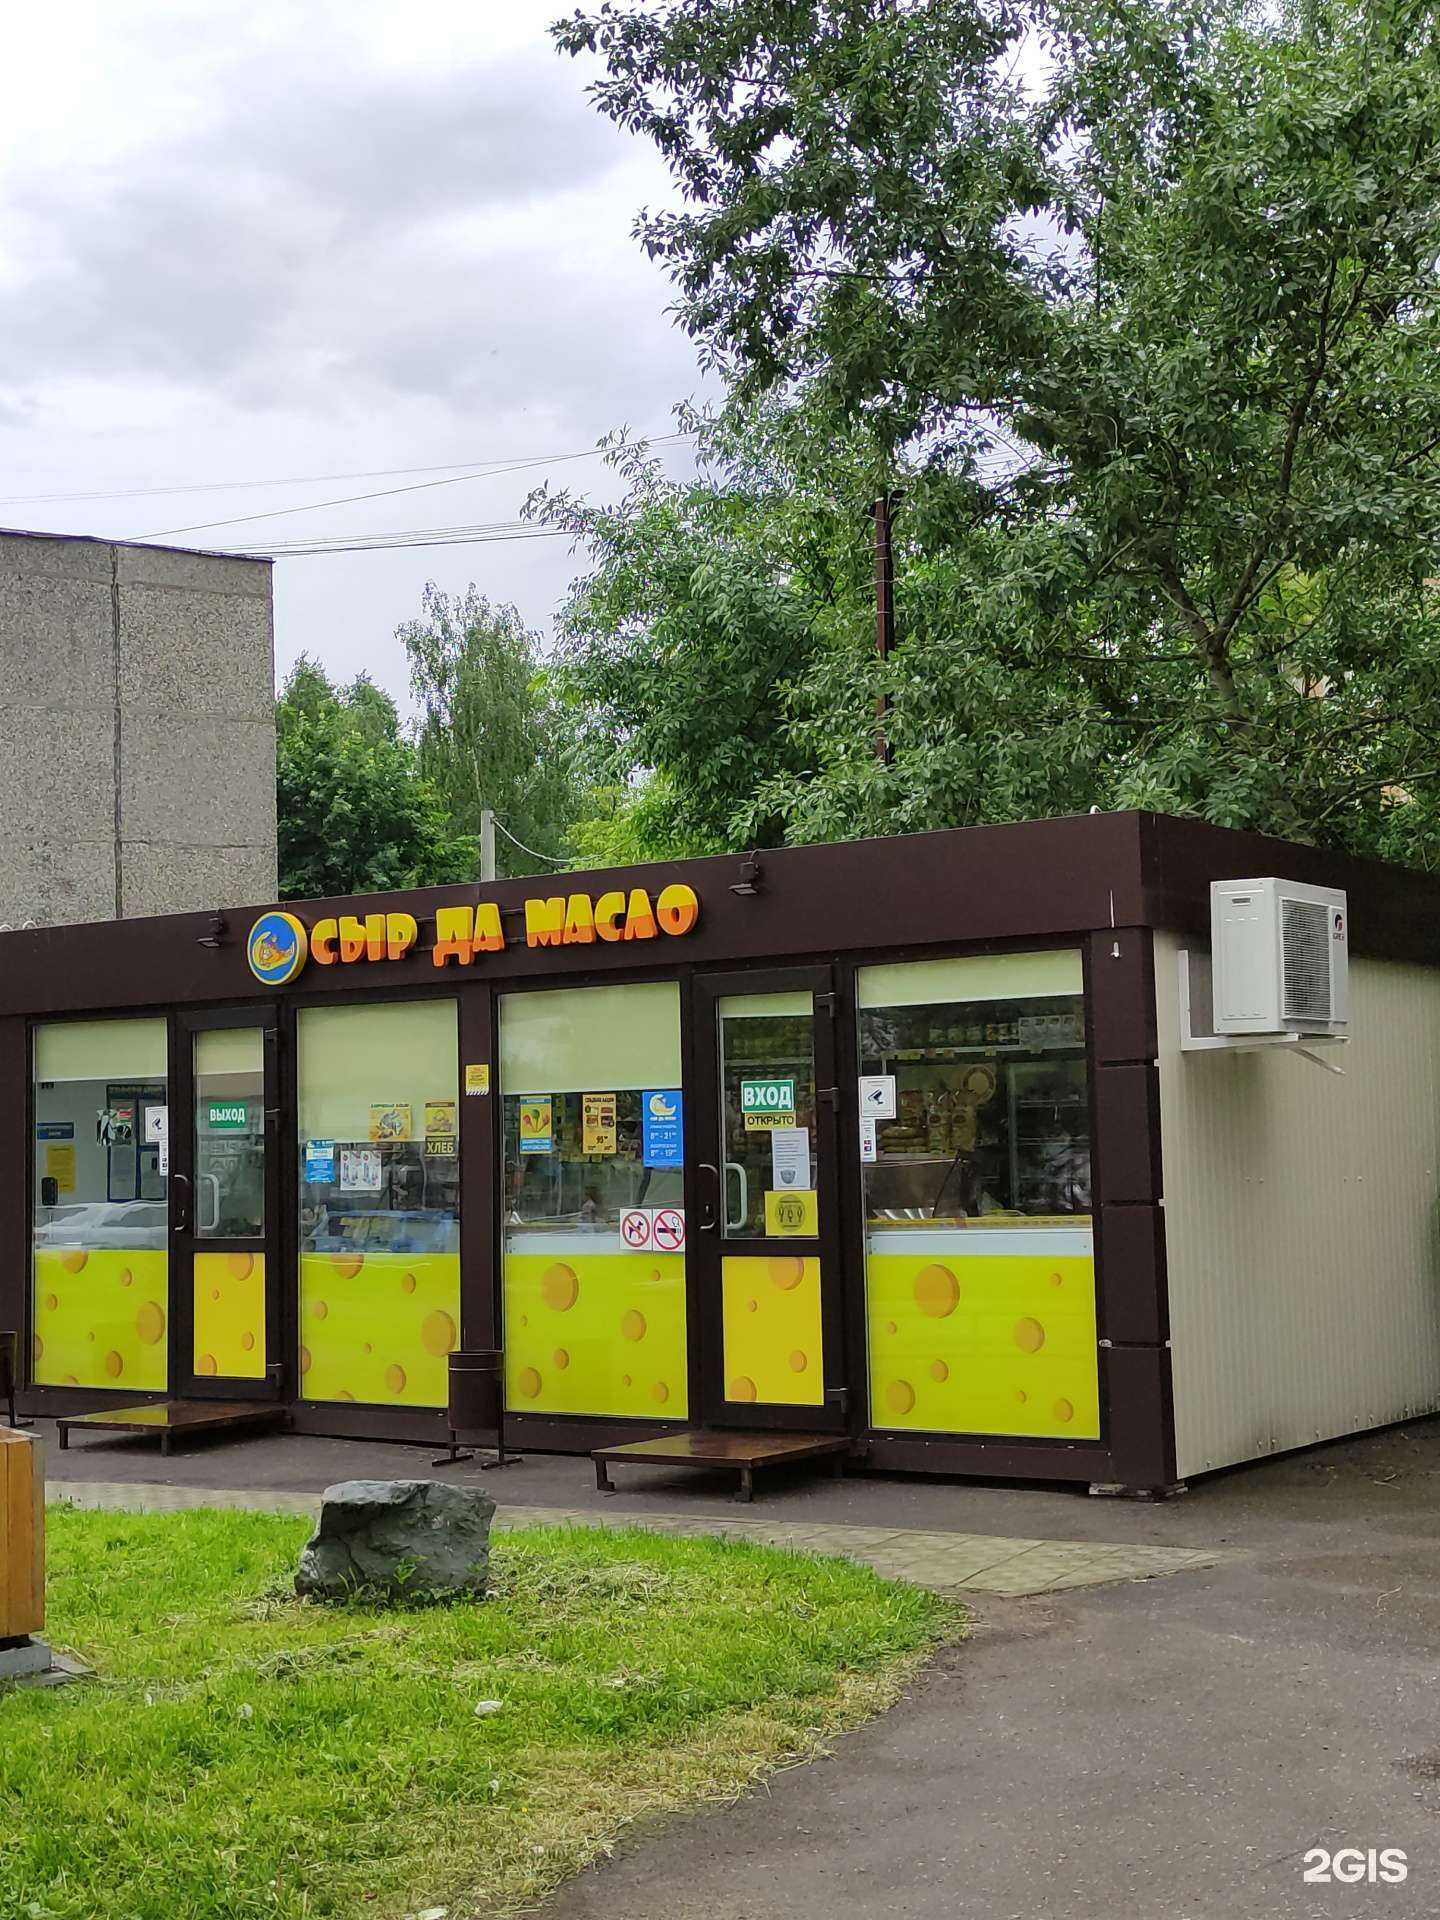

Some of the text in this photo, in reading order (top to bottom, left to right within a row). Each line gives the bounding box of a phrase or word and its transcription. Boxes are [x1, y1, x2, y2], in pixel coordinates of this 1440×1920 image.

[310, 884, 699, 967] СЫР ДА МАСЛО
[743, 1085, 792, 1109] ВХОД
[209, 1106, 246, 1123] ВЫХОД
[747, 1115, 795, 1126] ОТКРЫТО
[426, 1142, 454, 1154] ХЛЕБ
